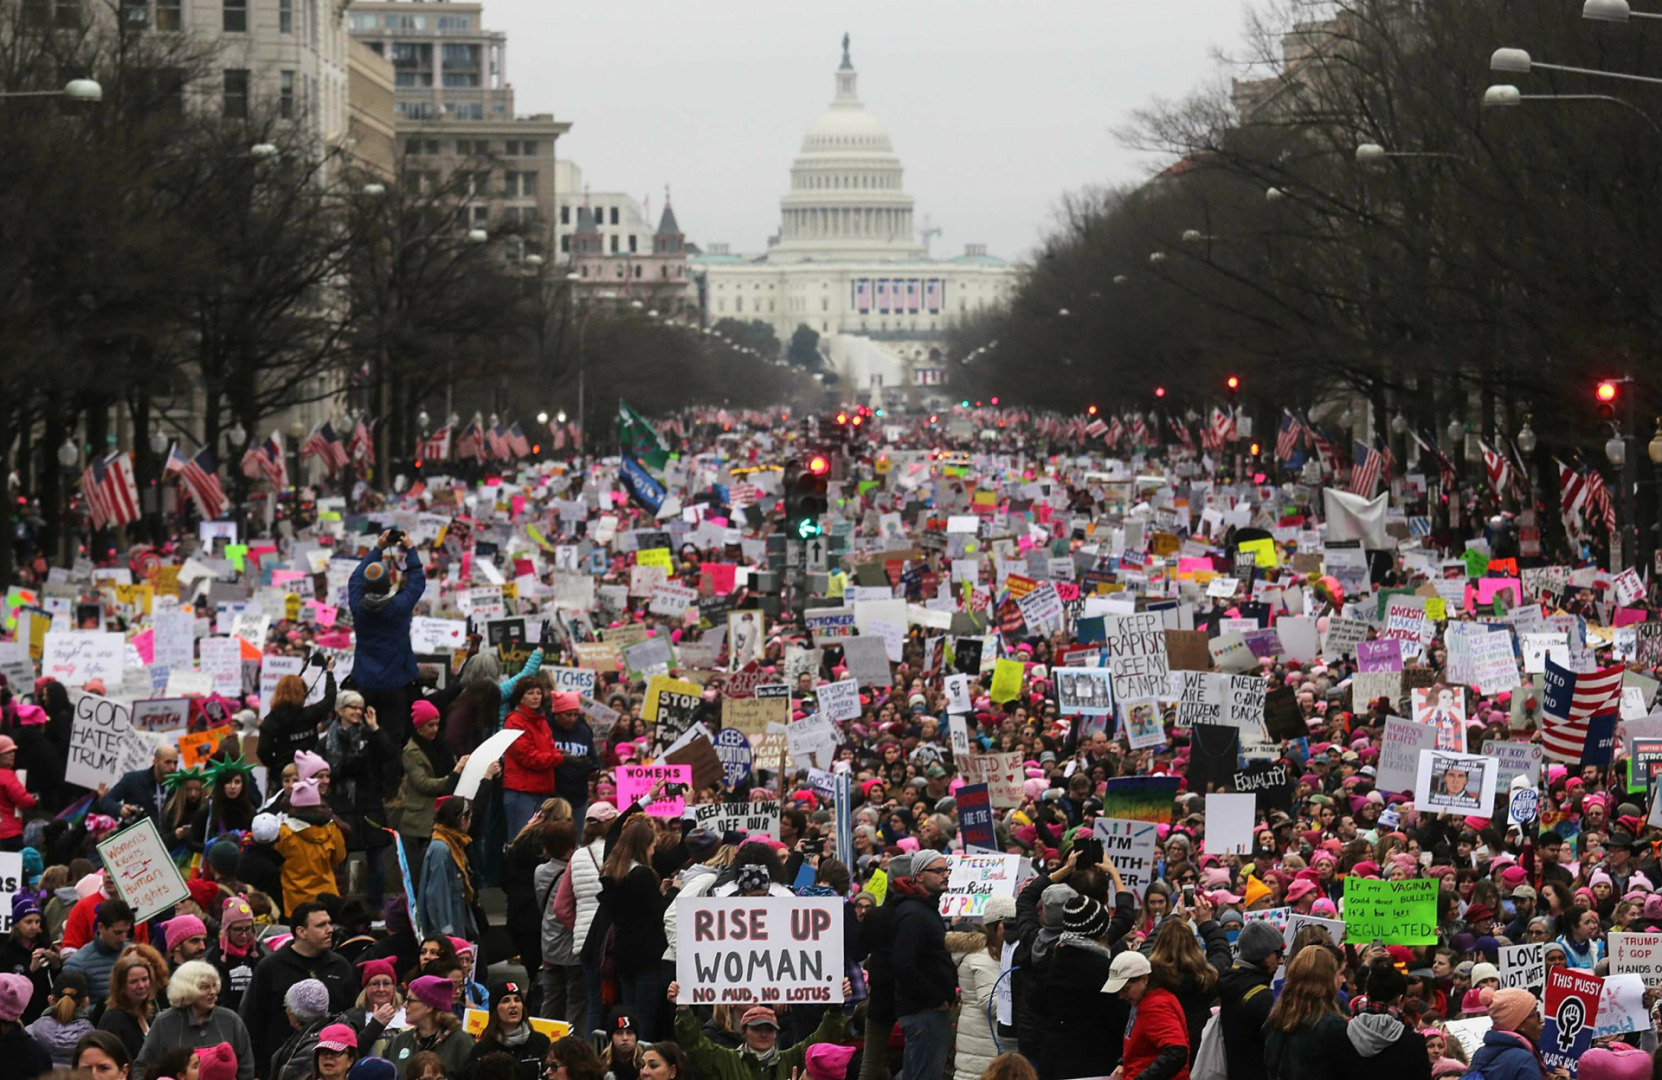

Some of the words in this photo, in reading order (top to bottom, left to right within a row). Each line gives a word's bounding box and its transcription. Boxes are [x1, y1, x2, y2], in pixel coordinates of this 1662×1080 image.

[805, 614, 855, 628] STRONGER
[1390, 605, 1426, 621] DIVERSITY
[1117, 615, 1156, 635] KEEP
[1390, 616, 1421, 631] MAKES
[1386, 628, 1421, 642] AMERICA
[1107, 631, 1167, 657] RAPISTS
[1365, 641, 1389, 654] Yes
[1399, 642, 1416, 655] EAT
[1114, 656, 1144, 677] OFF
[1147, 654, 1167, 679] MY
[555, 670, 593, 687] TCHES
[1115, 675, 1171, 699] CAMPUS
[1184, 672, 1207, 689] WE
[1231, 675, 1266, 693] NEVER
[1544, 671, 1565, 687] ITED
[660, 691, 700, 709] STOP
[1181, 689, 1205, 703] ARE
[77, 696, 129, 733] GOD
[1180, 703, 1220, 718] CITIZENS
[1231, 705, 1261, 725] BACK
[719, 729, 745, 746] KEEP
[765, 734, 785, 745] MY
[1387, 731, 1418, 747] RIGHTS
[714, 744, 751, 764] BORTION
[1508, 747, 1527, 758] BODY
[1005, 755, 1022, 772] WE
[625, 769, 680, 778] WOMENS
[723, 763, 747, 785] EGAL
[1233, 764, 1287, 791] EQUALITY
[695, 803, 722, 822] KEEP
[723, 802, 750, 817] YOUR
[753, 801, 780, 819] LAWS
[718, 818, 740, 833] OFF
[747, 816, 769, 831] OUR
[1107, 836, 1132, 850] I'M
[123, 868, 164, 895] Human
[1119, 873, 1139, 887] ER
[1390, 881, 1432, 894] VAGINA
[1400, 893, 1436, 904] BULLETS
[1374, 908, 1386, 917] be
[694, 908, 769, 941] RISE
[790, 908, 831, 941] UP
[1345, 923, 1432, 938] REGULATED
[1624, 936, 1659, 946] TRUMP
[1507, 944, 1544, 969] LOVE
[1630, 950, 1652, 959] GOP
[694, 949, 833, 984] WOMAN.
[1617, 964, 1651, 974] HANDS
[1500, 970, 1523, 989] NOT
[1525, 966, 1544, 983] HATE
[1552, 971, 1573, 989] THIS
[1574, 977, 1602, 997] PUSSY
[692, 987, 716, 1003] NO
[721, 987, 759, 1005] MUD,
[760, 987, 780, 1003] NO
[785, 986, 831, 1002] LOTUS
[1544, 1051, 1568, 1068] RABS
[1569, 1054, 1580, 1073] BAC
